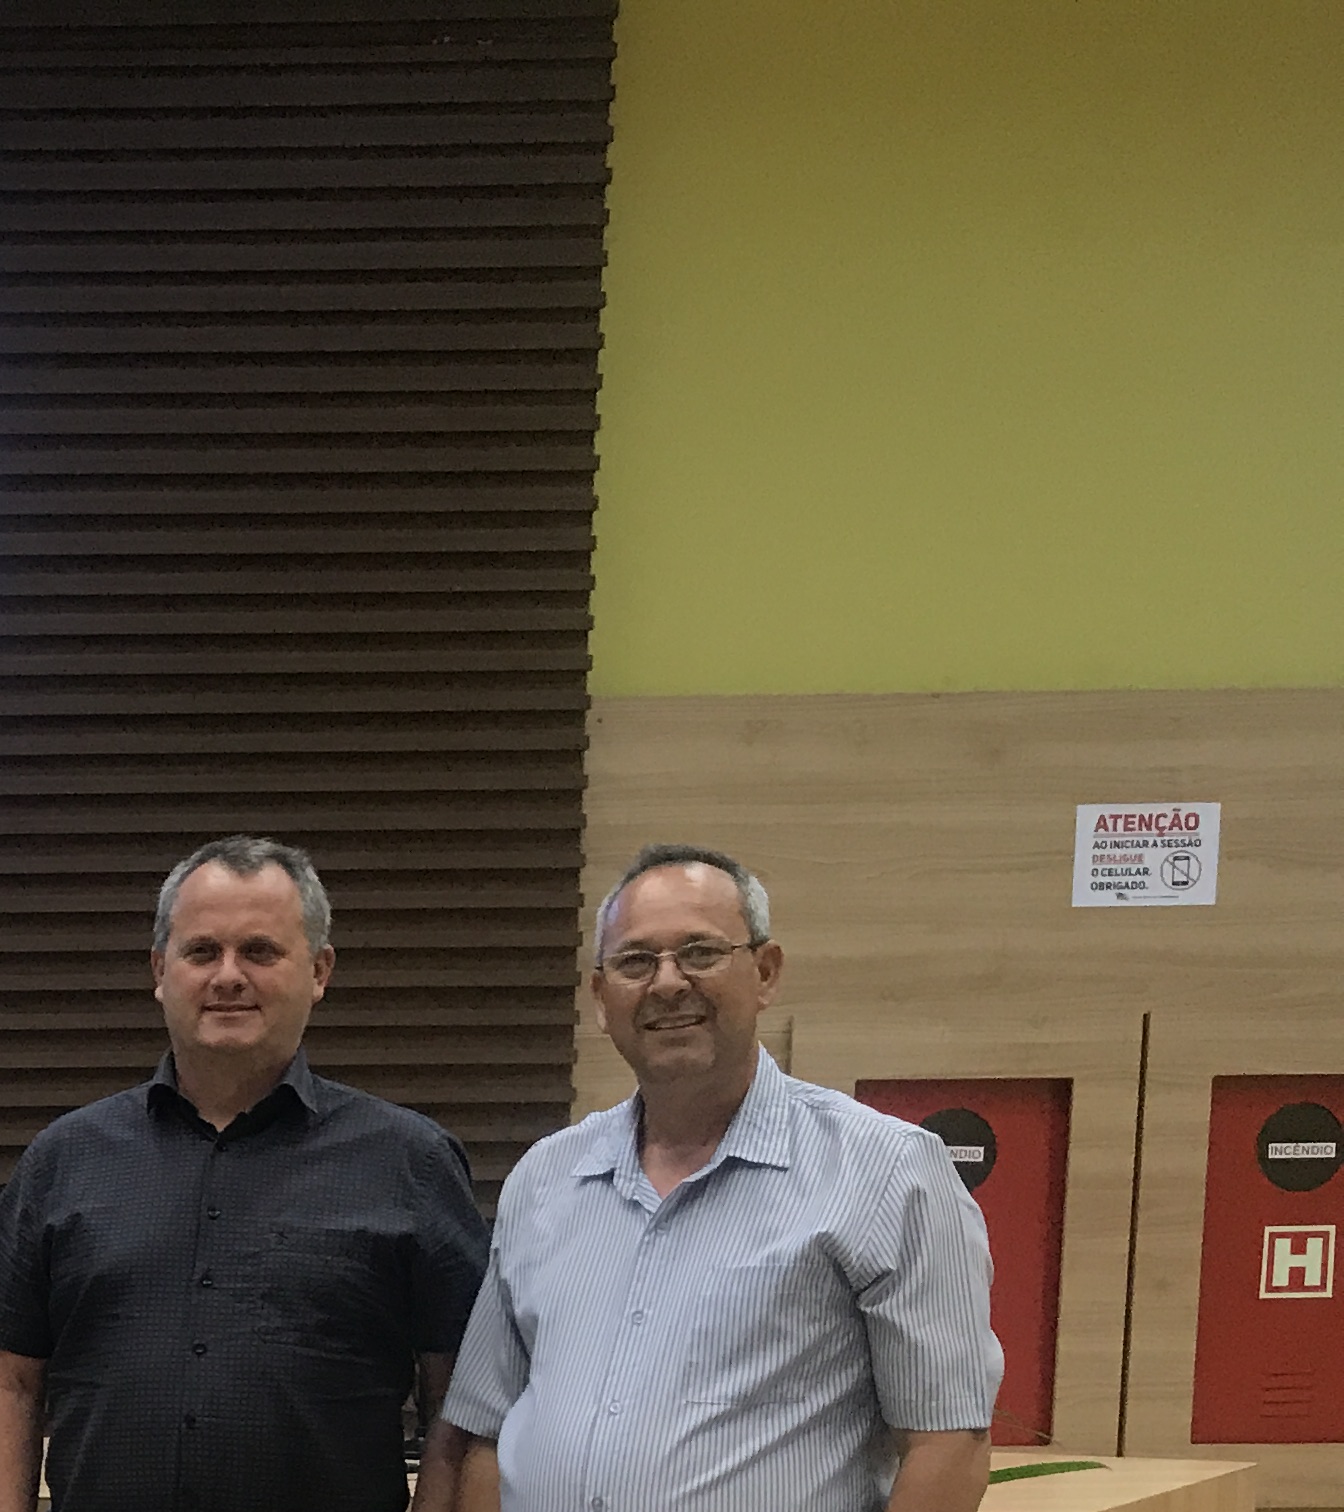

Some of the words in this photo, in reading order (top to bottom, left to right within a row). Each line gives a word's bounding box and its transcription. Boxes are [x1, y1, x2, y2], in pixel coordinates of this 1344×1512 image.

[1093, 808, 1200, 837] ATENÇÃO
[1092, 840, 1108, 850] AO
[1110, 839, 1150, 849] INICIAR
[1151, 839, 1159, 849] A
[1092, 853, 1144, 864] DESLIGUE
[1091, 868, 1099, 877] O
[1090, 881, 1148, 891] OBRIGADO.
[1270, 1143, 1334, 1156] INCÊNDIO
[1271, 1237, 1324, 1287] H
